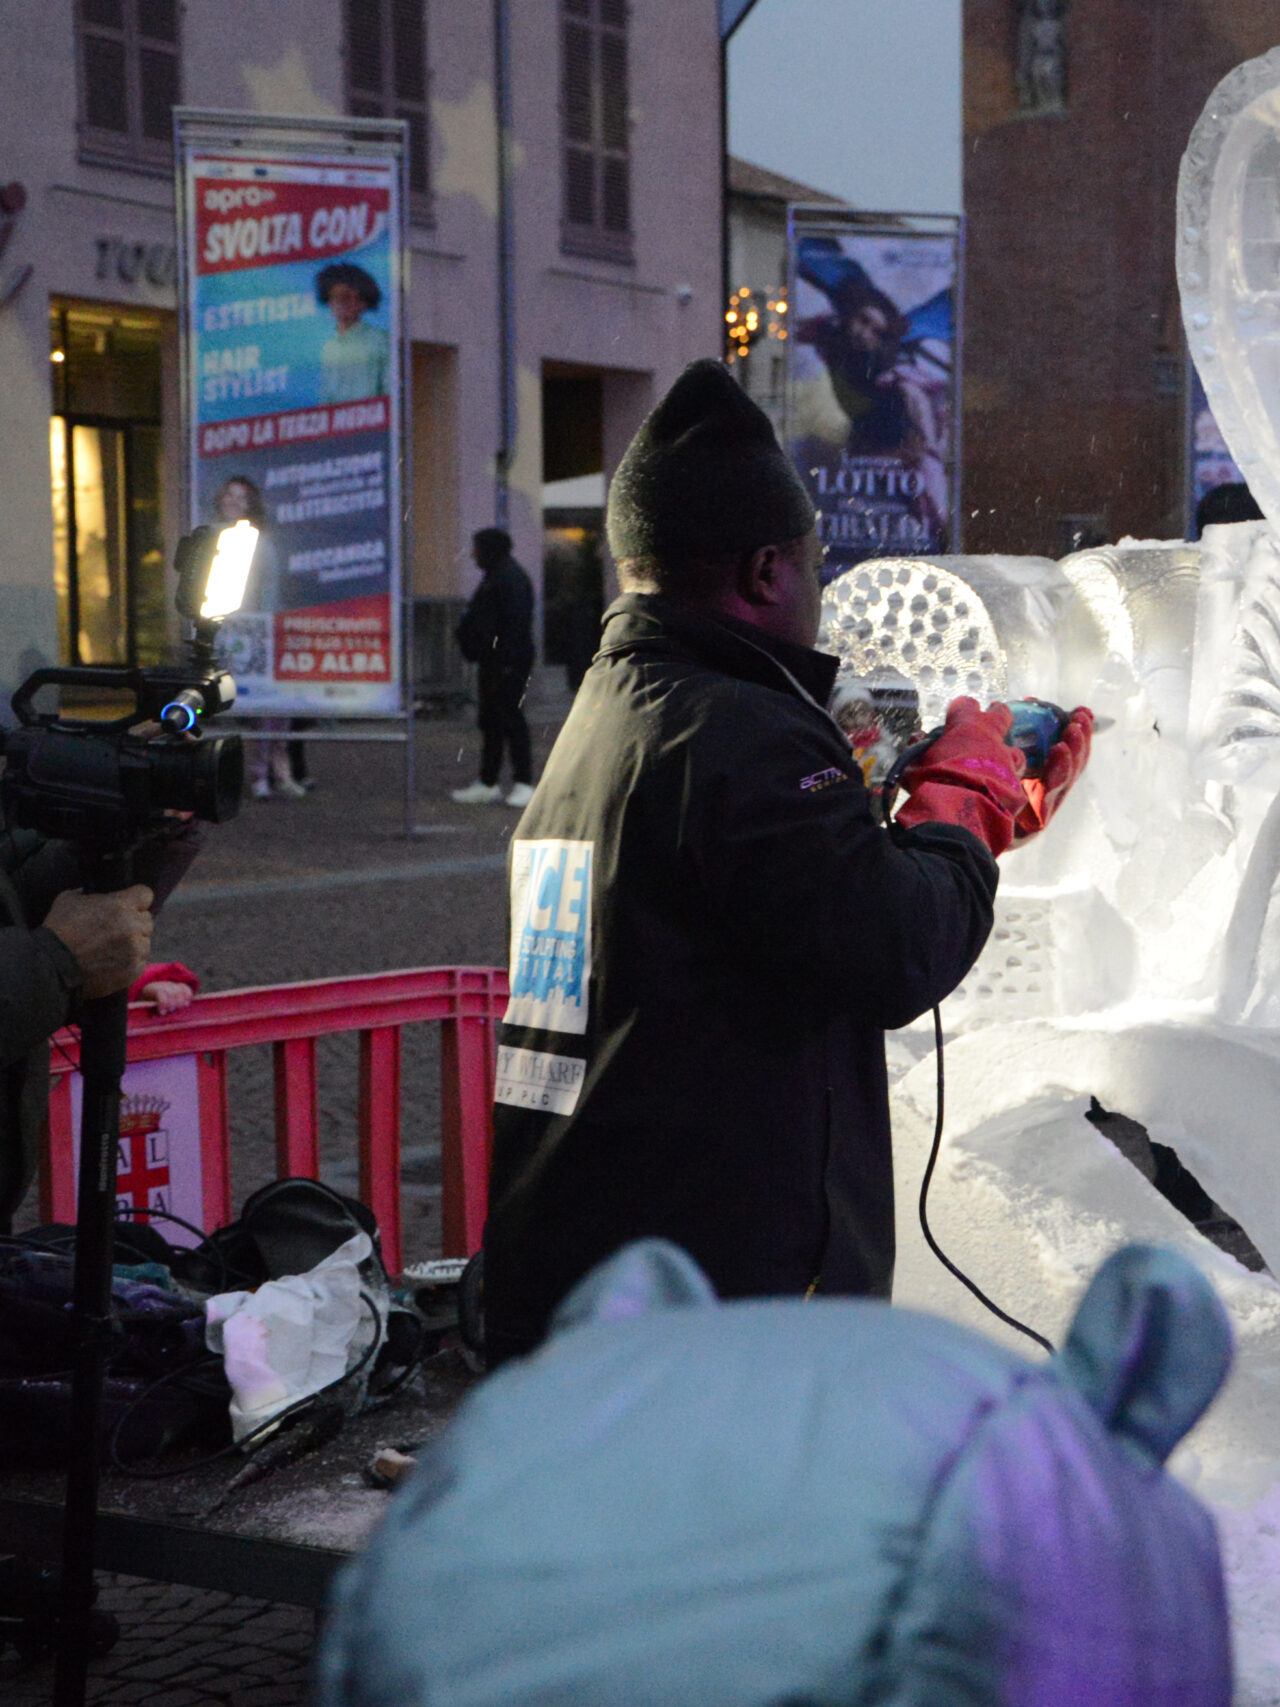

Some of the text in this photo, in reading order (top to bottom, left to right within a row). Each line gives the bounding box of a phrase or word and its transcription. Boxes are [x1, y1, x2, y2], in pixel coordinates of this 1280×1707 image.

[203, 200, 368, 264] SVOLTA CON
[204, 345, 260, 376] HAIR
[203, 423, 249, 452] DOPO
[252, 416, 276, 445] LA
[818, 466, 925, 496] LOTTO
[280, 651, 387, 674] AD ALBA
